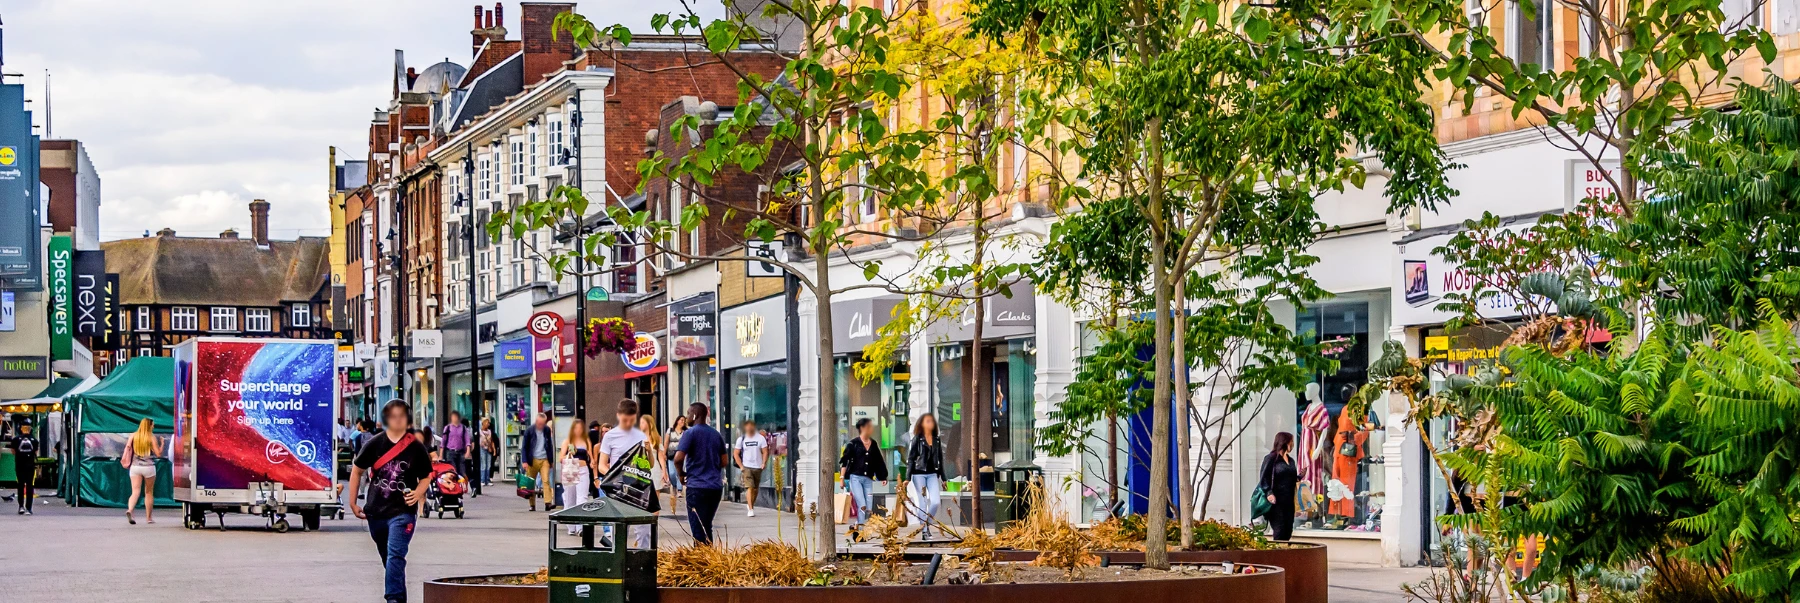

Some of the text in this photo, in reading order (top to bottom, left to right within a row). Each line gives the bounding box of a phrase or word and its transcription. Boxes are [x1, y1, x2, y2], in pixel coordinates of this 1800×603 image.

[1443, 269, 1492, 292] MOBIS
[52, 250, 69, 335] Specsavers
[78, 274, 97, 333] next
[680, 314, 706, 323] carpet
[996, 310, 1031, 321] Clarks
[418, 338, 436, 346] M&S
[632, 341, 655, 351] RGER
[628, 346, 655, 362] KING
[220, 379, 311, 396] Supercharge
[227, 398, 304, 412] your world
[237, 416, 294, 426] Sign up here
[566, 564, 599, 575] Litter
